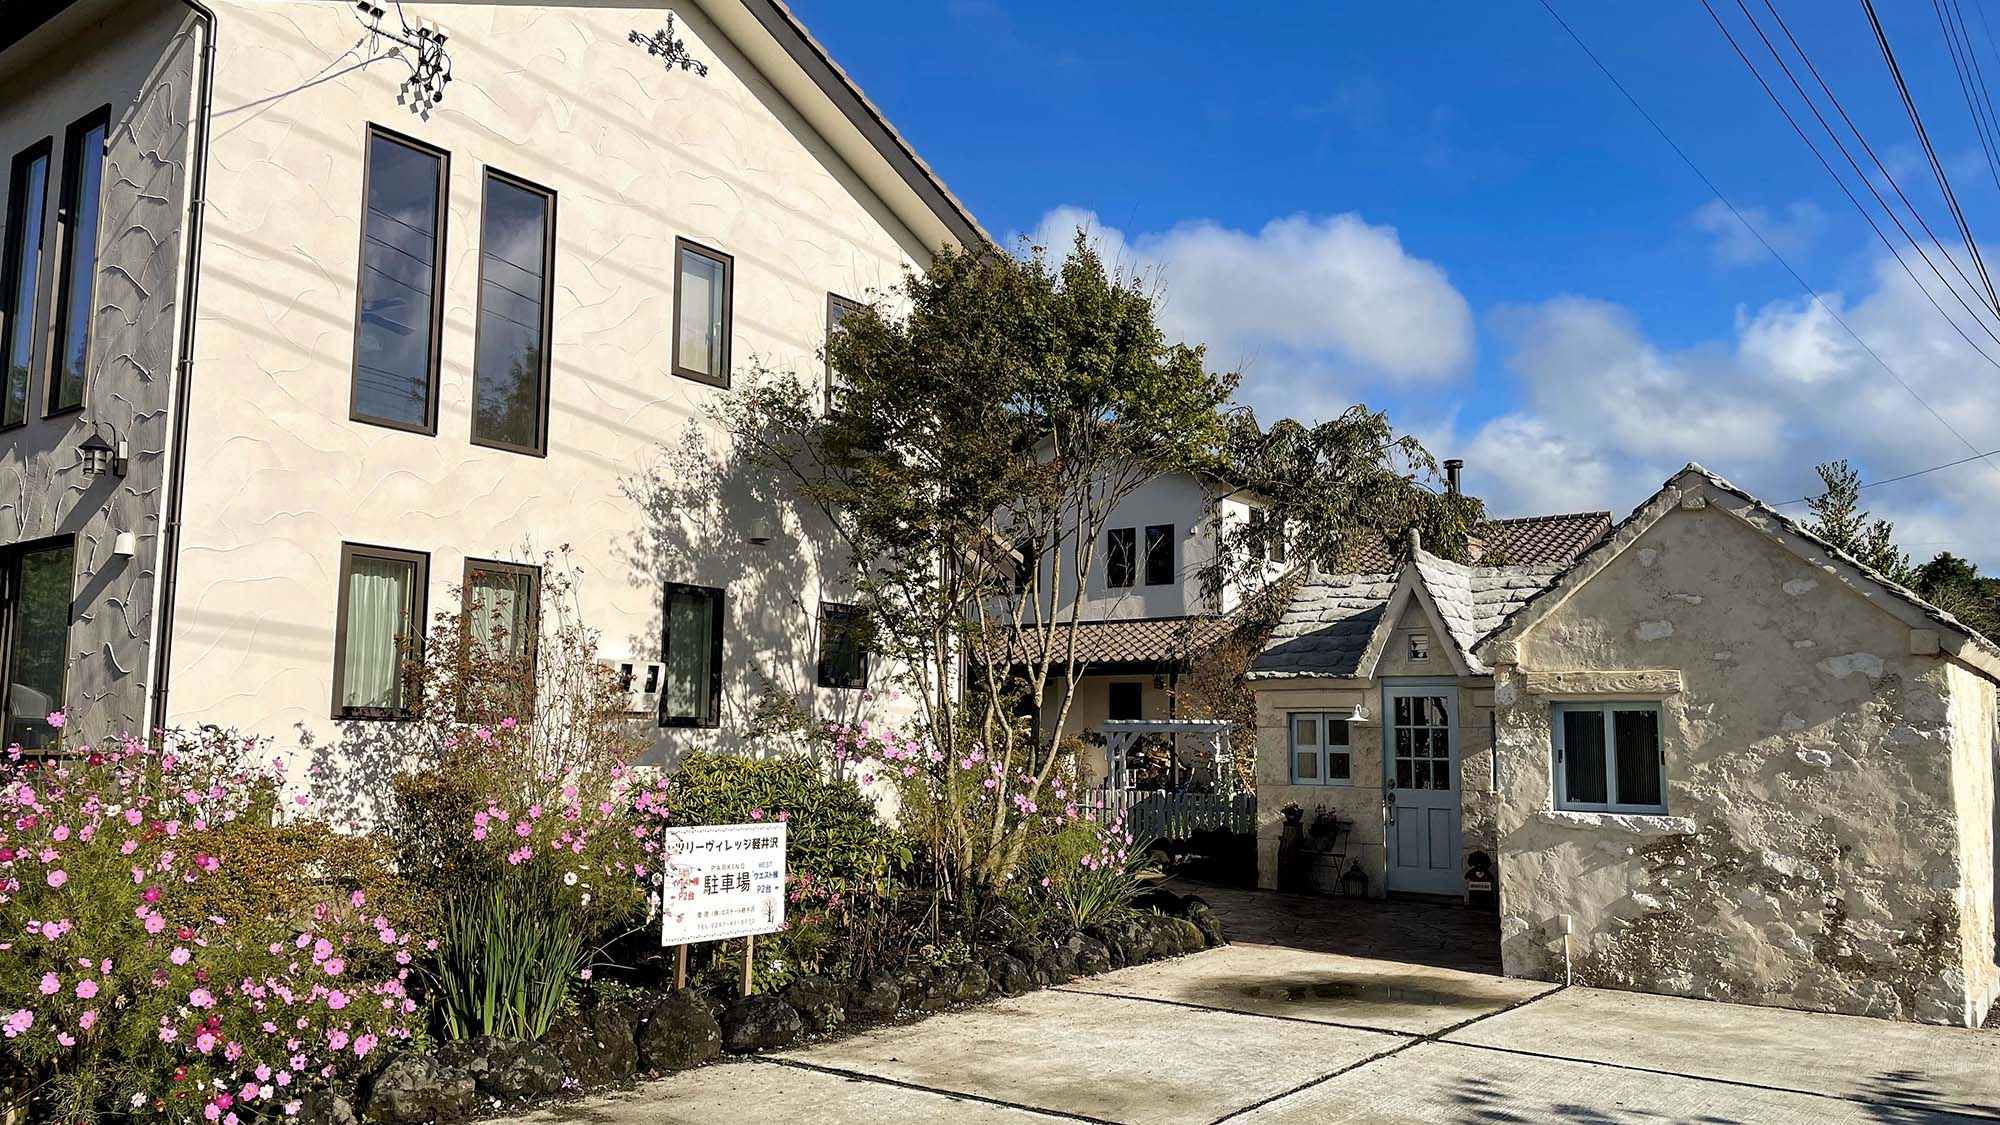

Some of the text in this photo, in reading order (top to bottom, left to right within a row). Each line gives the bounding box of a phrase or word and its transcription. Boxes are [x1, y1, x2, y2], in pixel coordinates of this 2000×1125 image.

[711, 863, 745, 871] PARKING
[703, 872, 751, 895] 駐車場
[757, 885, 772, 893] P2台
[678, 892, 695, 901] P2台
